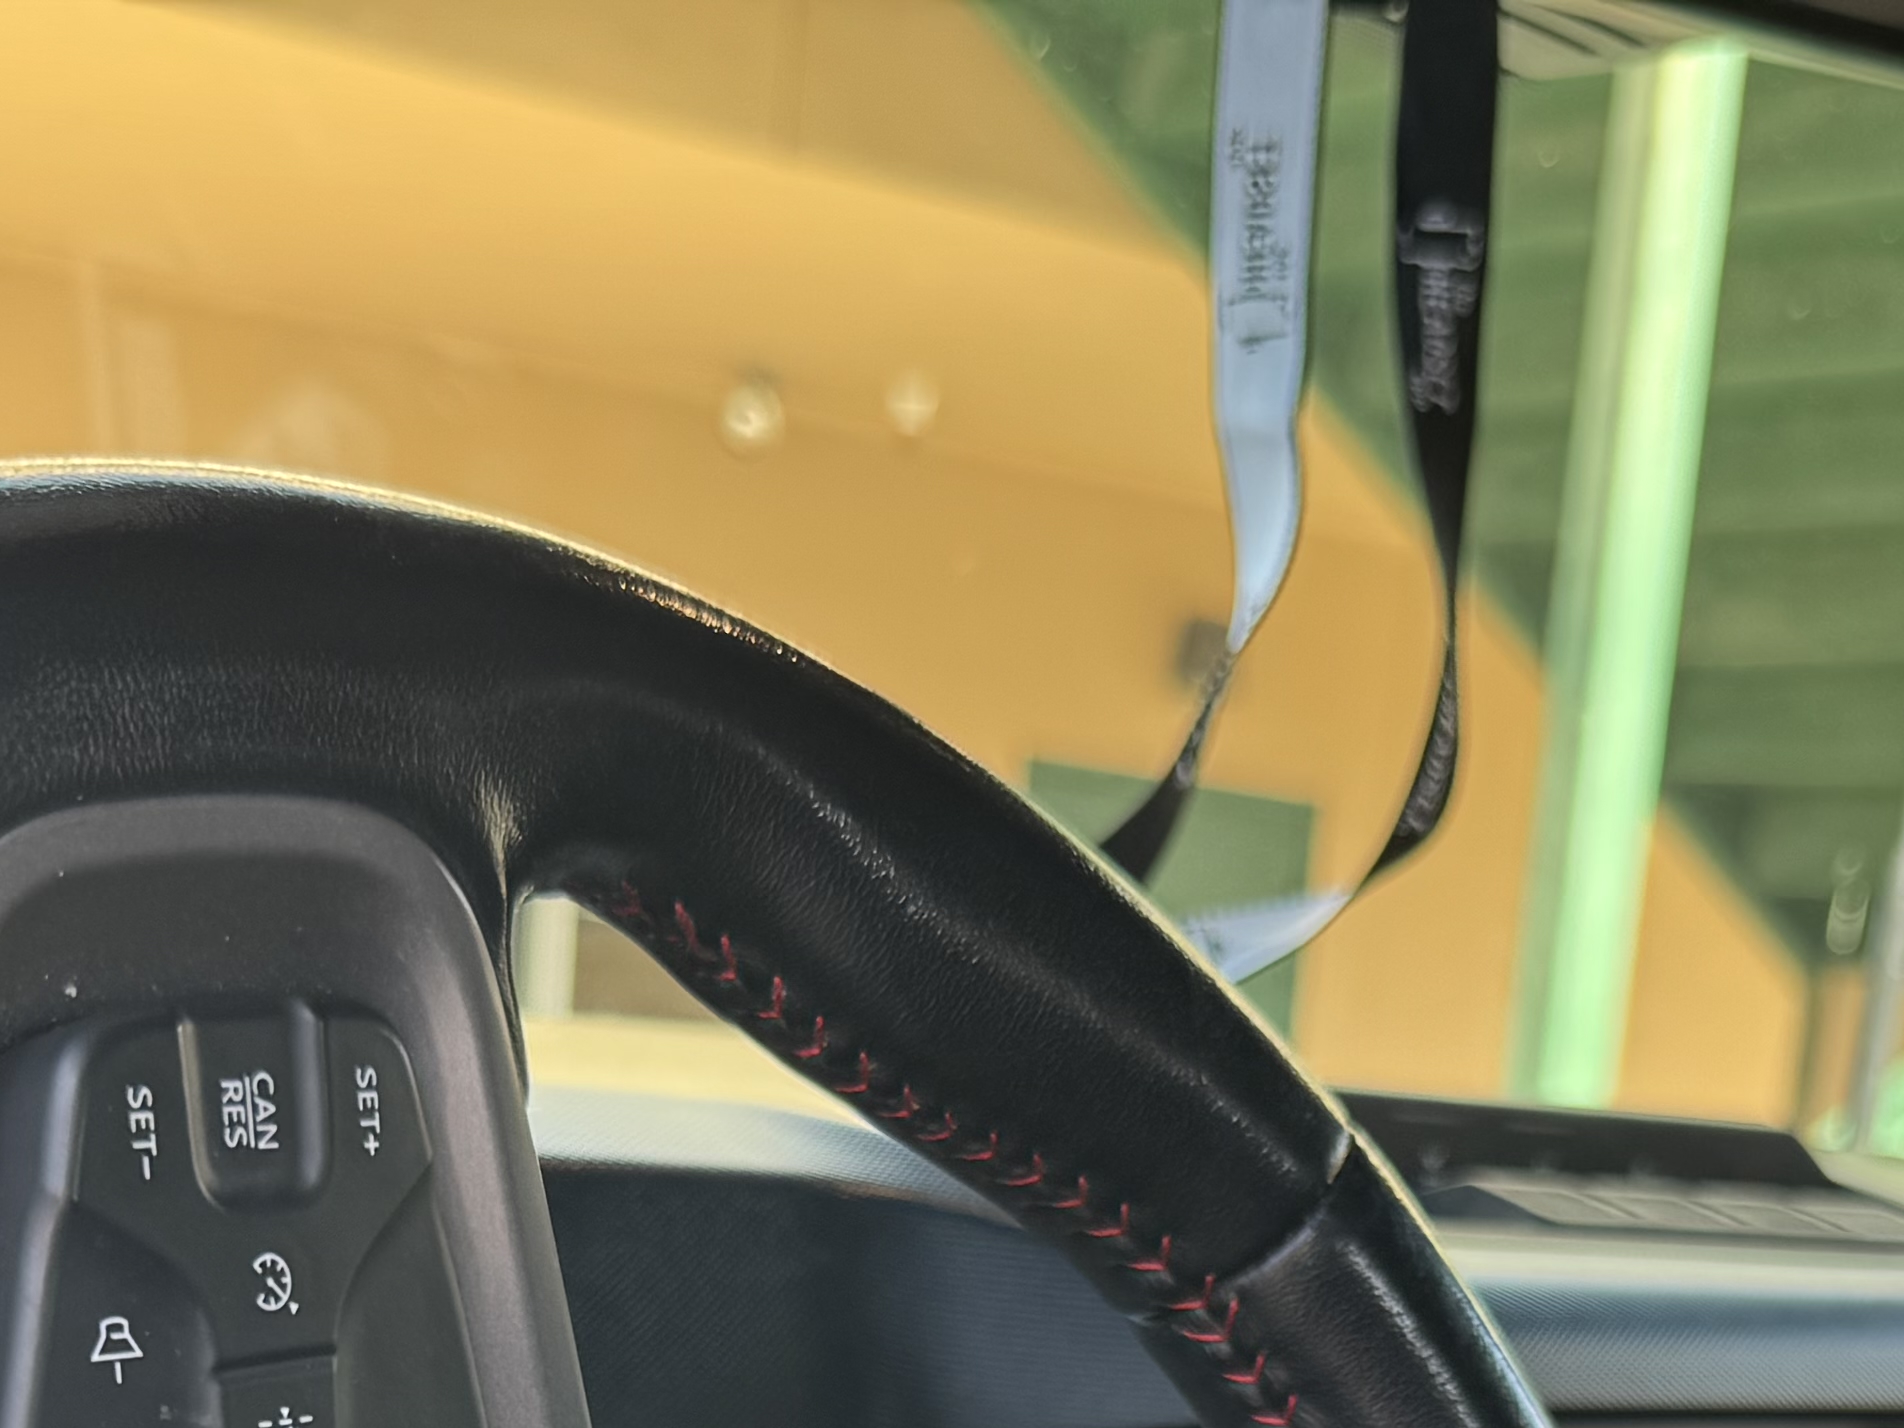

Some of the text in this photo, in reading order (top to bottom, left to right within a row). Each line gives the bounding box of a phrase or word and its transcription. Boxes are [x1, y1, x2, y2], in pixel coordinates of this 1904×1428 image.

[125, 1084, 158, 1181] SET-
[219, 1077, 248, 1150] RES
[251, 1069, 280, 1151] CAN
[354, 1064, 382, 1157] SET+
